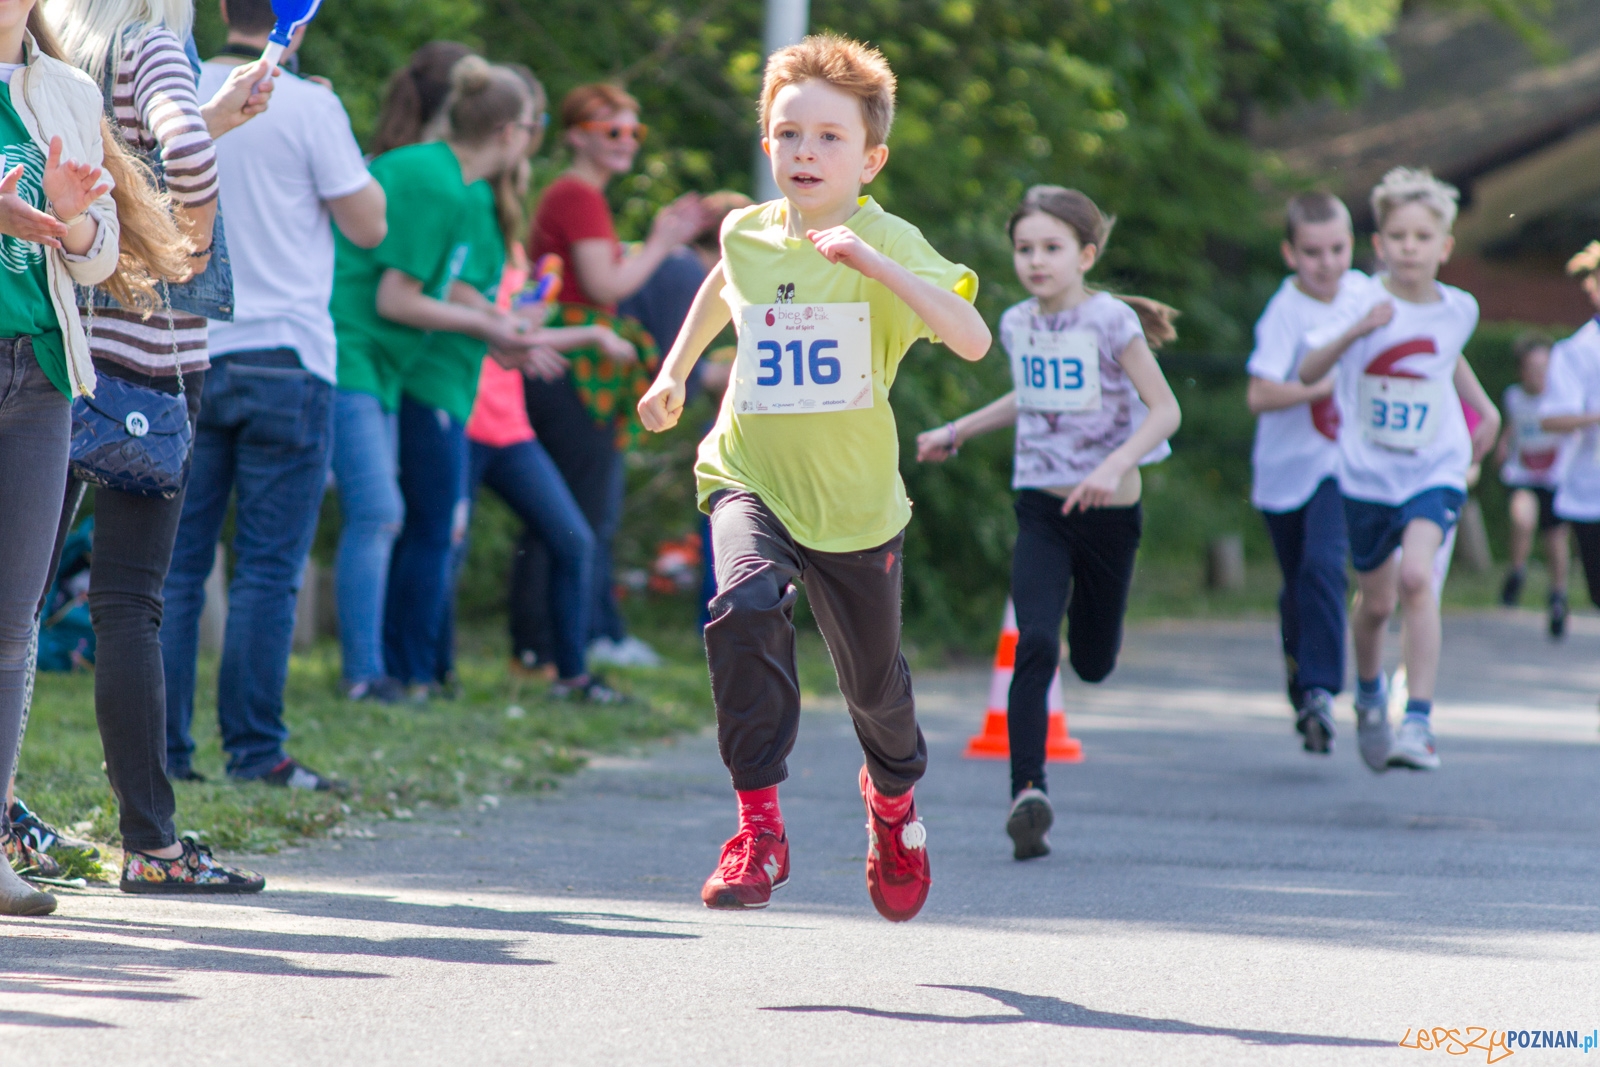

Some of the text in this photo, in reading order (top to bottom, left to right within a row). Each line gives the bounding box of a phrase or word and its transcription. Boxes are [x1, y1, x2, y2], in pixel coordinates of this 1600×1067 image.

[765, 306, 802, 327] 6 bieg
[814, 312, 829, 320] tak
[757, 339, 841, 386] 316
[1021, 355, 1085, 390] 1813
[1371, 399, 1430, 432] 337
